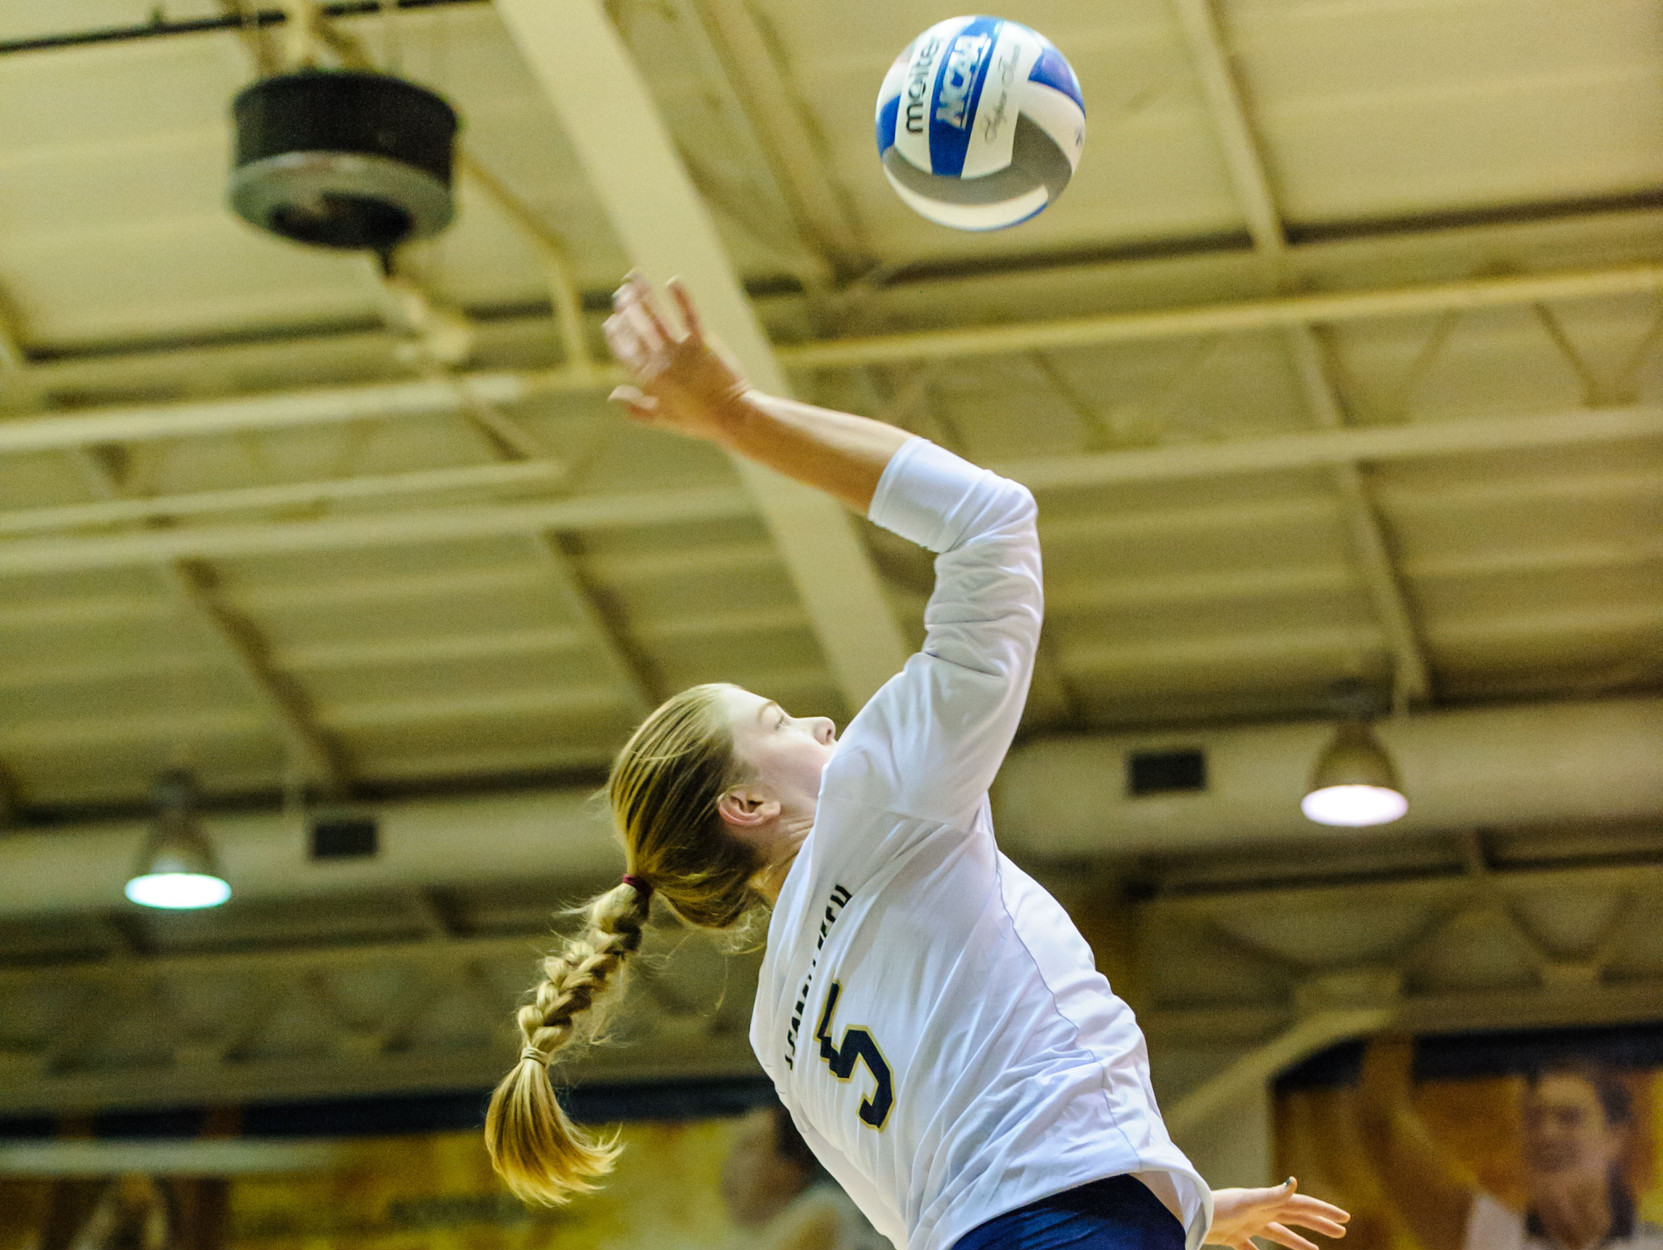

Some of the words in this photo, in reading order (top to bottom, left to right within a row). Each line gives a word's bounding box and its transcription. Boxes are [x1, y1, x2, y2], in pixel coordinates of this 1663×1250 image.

[906, 36, 940, 134] molte
[936, 34, 989, 131] NCAA
[814, 979, 896, 1132] 5
